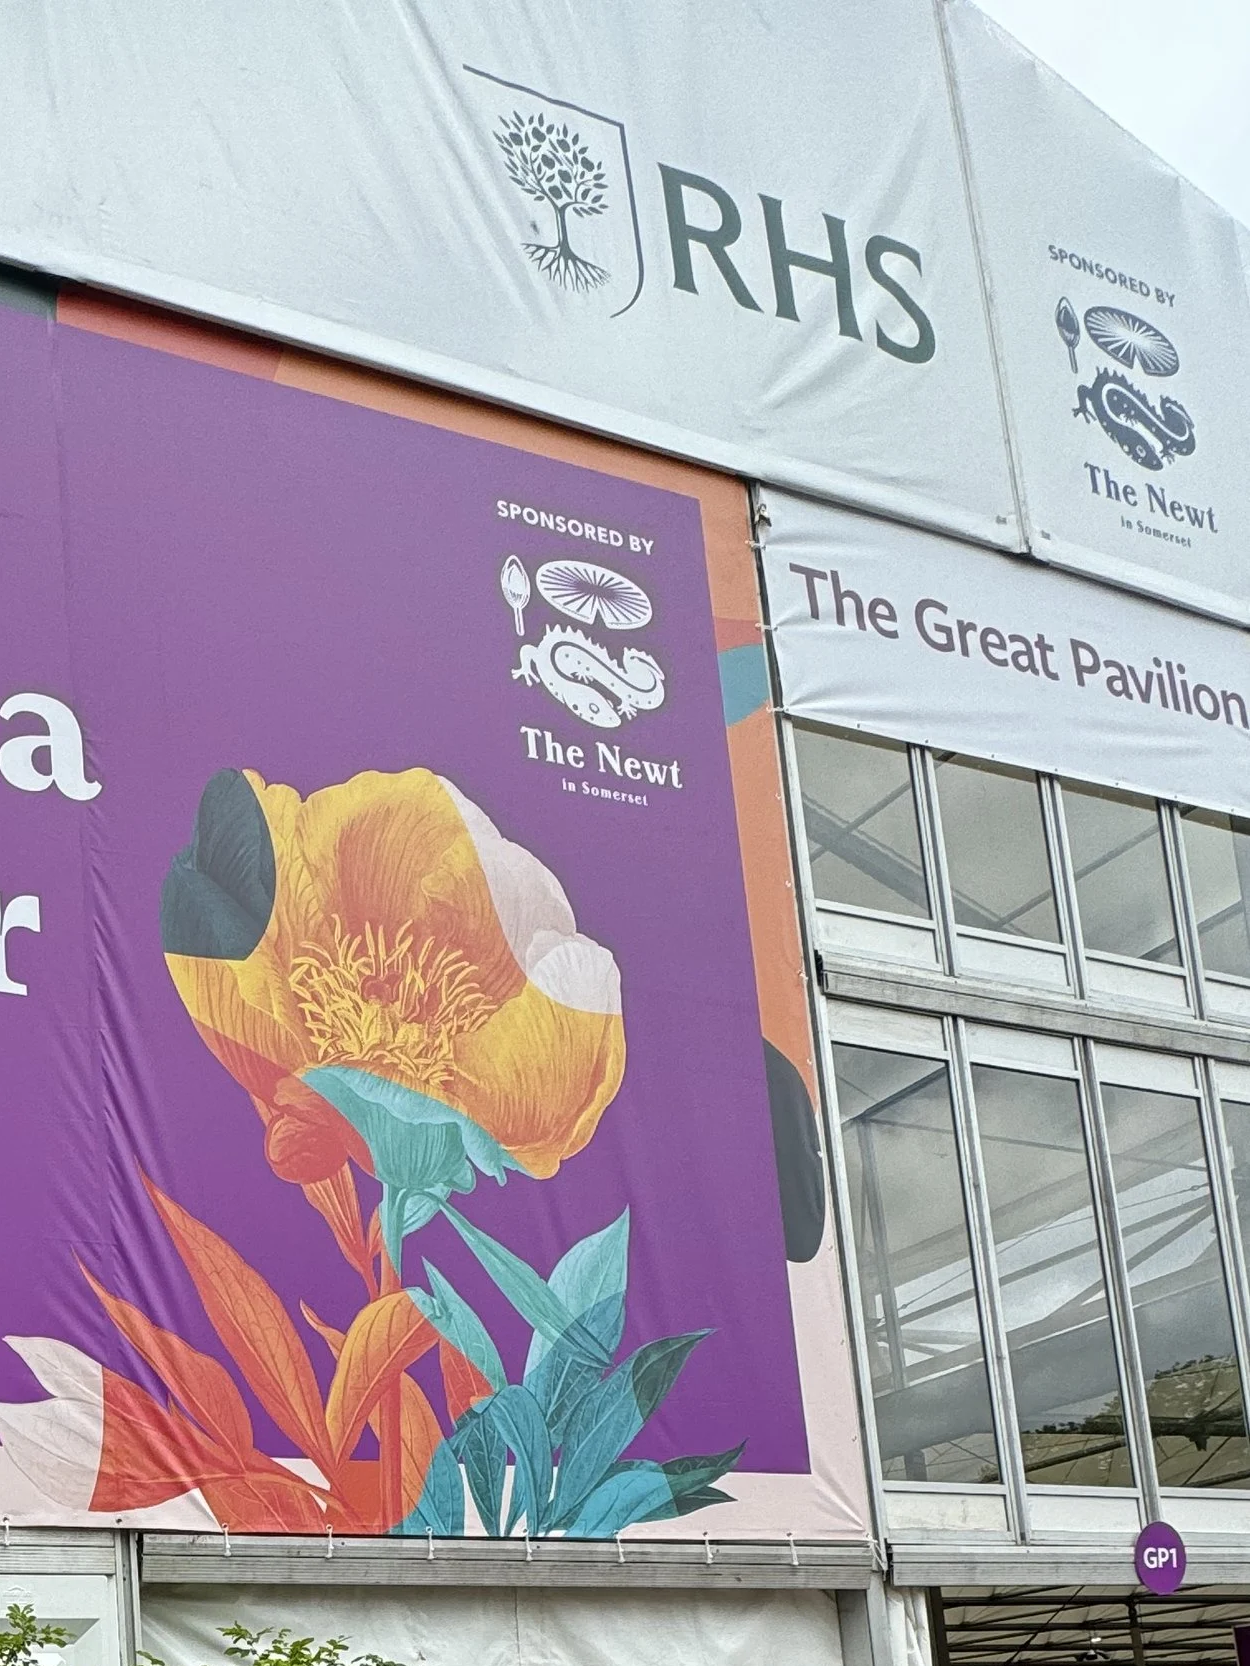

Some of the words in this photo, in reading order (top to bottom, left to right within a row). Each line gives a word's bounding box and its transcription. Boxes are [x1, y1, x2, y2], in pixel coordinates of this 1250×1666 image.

[657, 162, 936, 364] RHS
[1048, 244, 1151, 298] SPONSORED
[1154, 287, 1176, 307] BY
[496, 500, 624, 548] SPONSORED
[628, 534, 654, 556] BY
[1084, 461, 1138, 507] The
[1145, 482, 1219, 534] Newt
[1136, 519, 1192, 548] Somerset
[789, 562, 899, 640] The
[914, 598, 1060, 681] Great
[1069, 637, 1250, 731] Pavilion
[520, 725, 585, 769] The
[595, 741, 683, 789] Newt
[562, 778, 576, 792] in
[581, 781, 648, 806] Somerset
[1143, 1547, 1177, 1569] GP1
